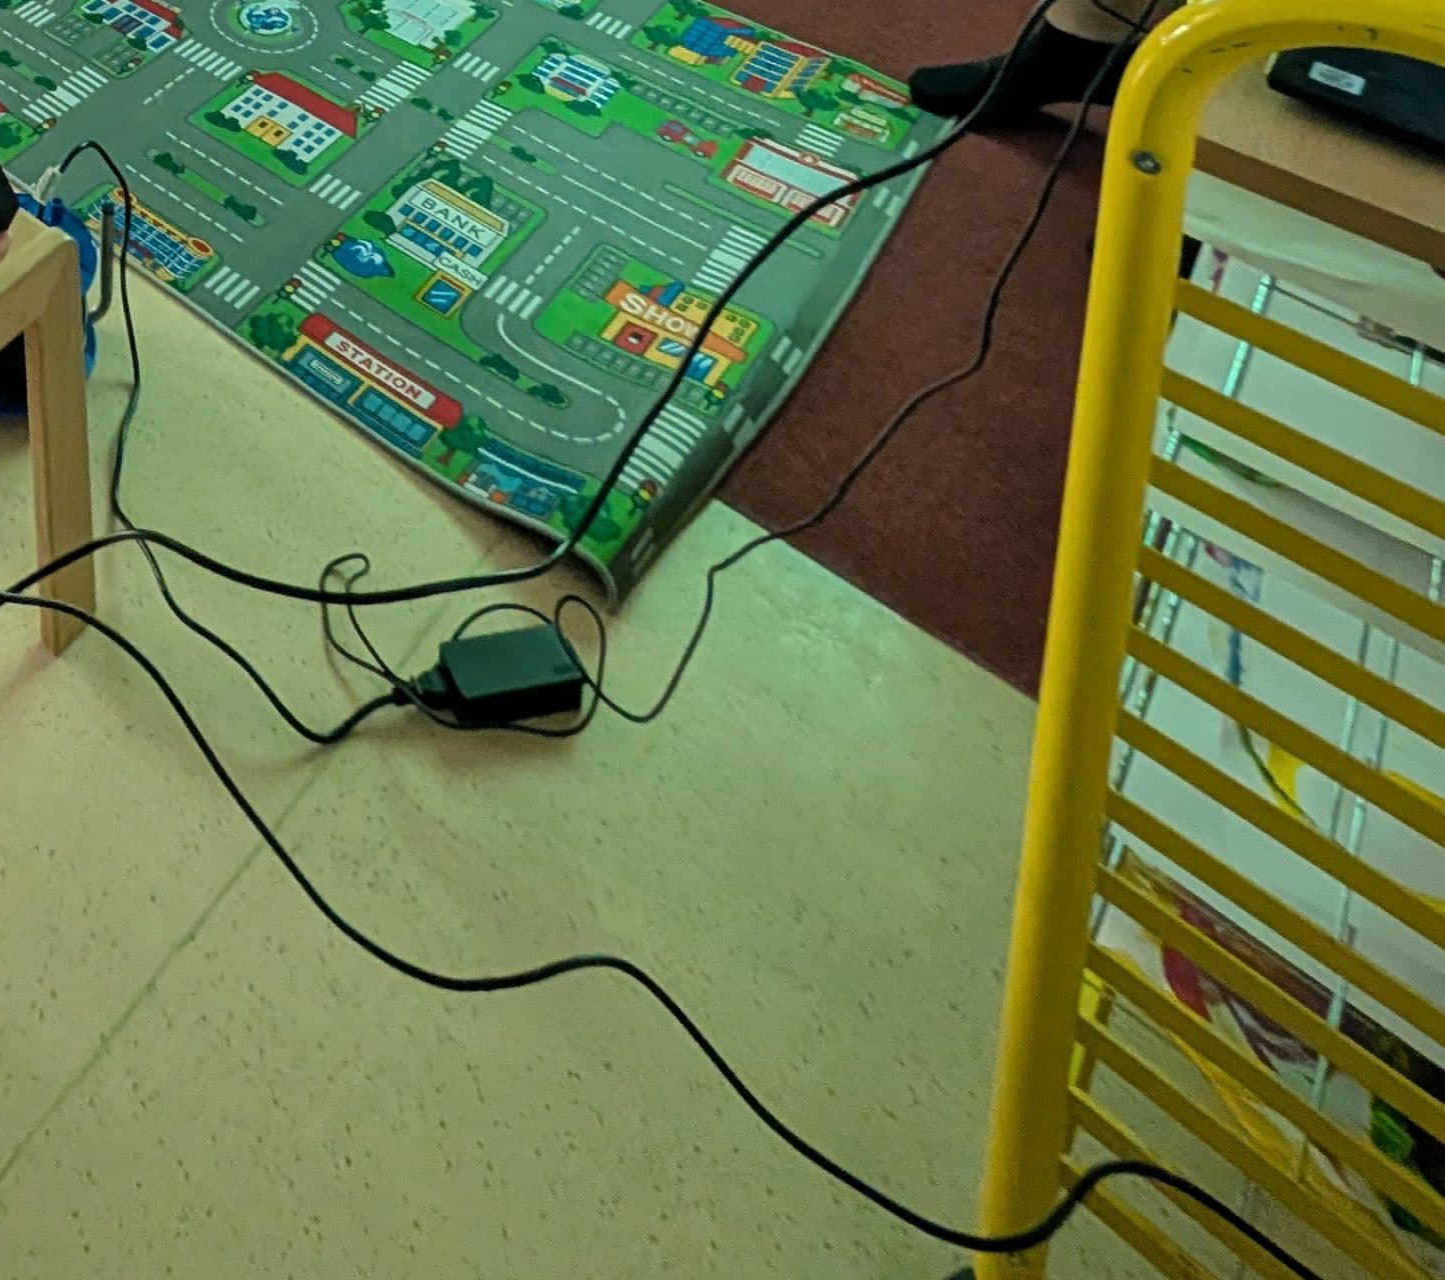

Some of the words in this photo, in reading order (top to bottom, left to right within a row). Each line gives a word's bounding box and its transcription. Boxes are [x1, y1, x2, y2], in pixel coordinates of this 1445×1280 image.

[421, 197, 486, 239] BANK
[438, 255, 482, 286] CASH
[336, 340, 422, 400] STATION
